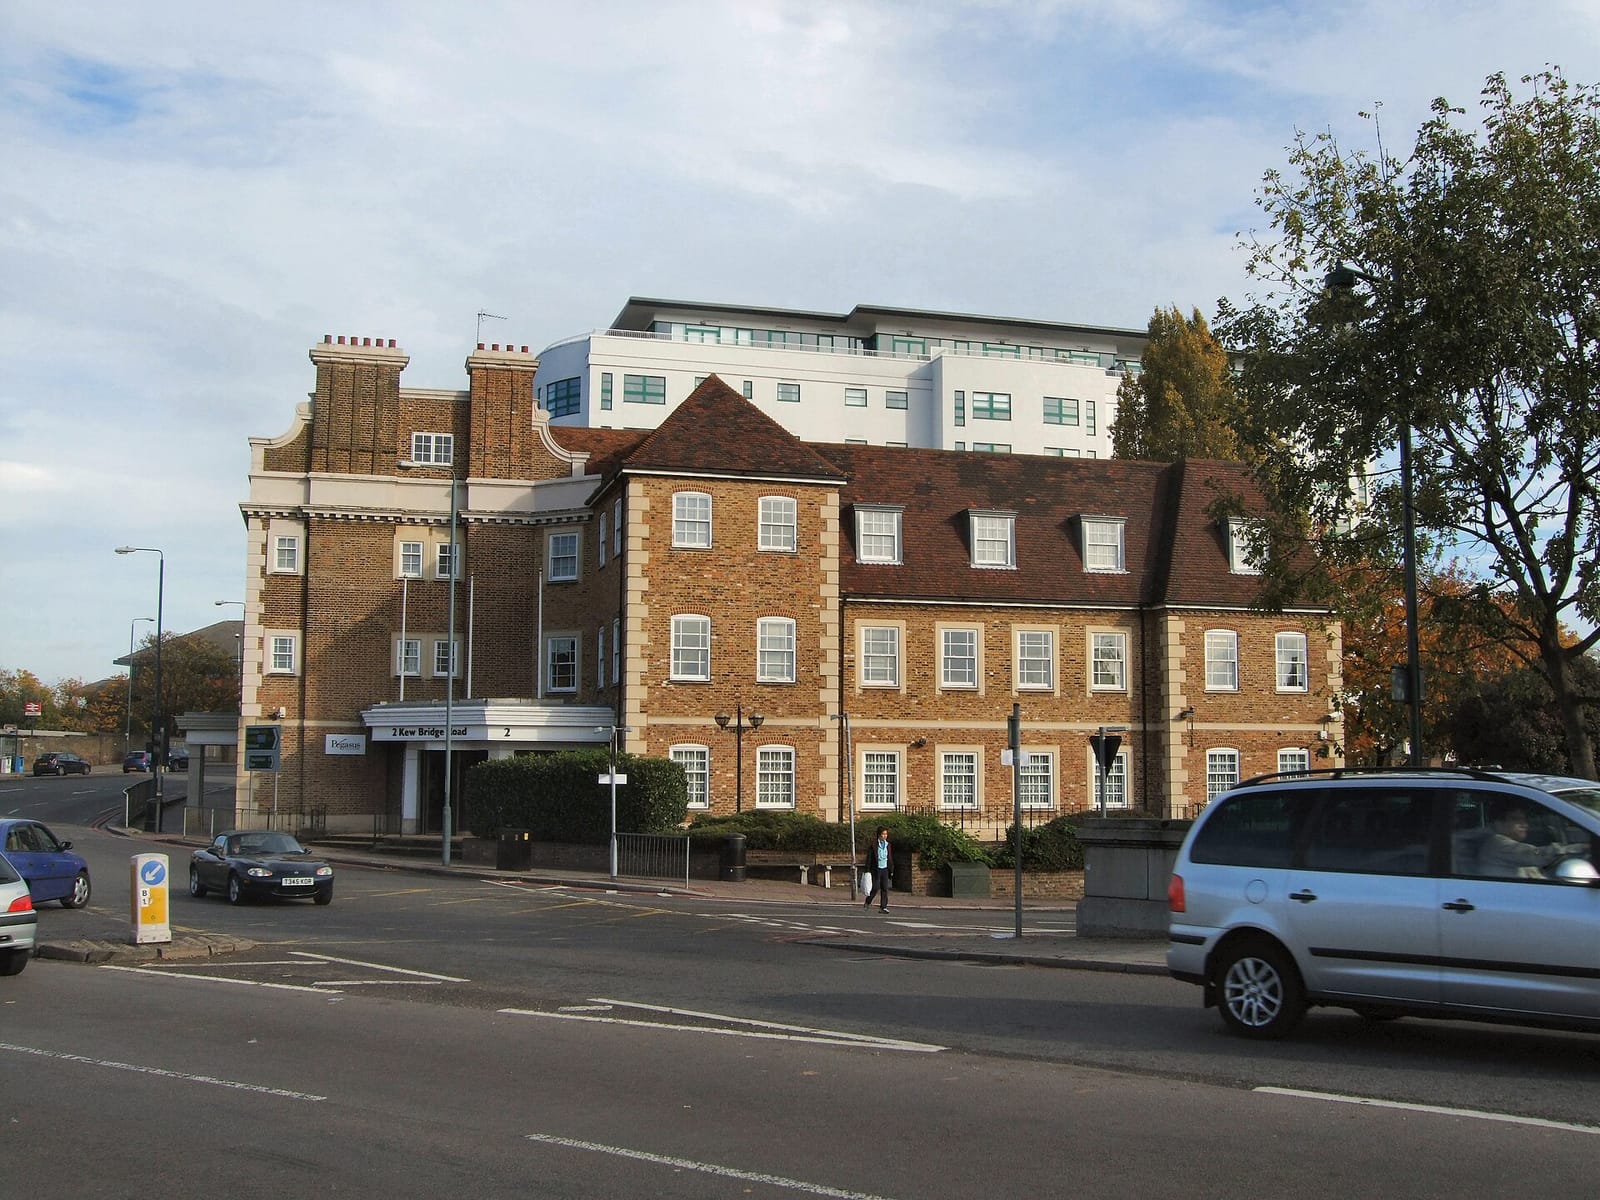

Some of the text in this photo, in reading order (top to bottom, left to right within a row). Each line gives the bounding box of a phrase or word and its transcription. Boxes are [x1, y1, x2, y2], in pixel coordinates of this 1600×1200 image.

[392, 728, 397, 736] 2
[399, 728, 416, 736] Kew
[418, 728, 445, 738] Bridge
[503, 728, 511, 737] 2
[331, 739, 361, 750] Pegasus
